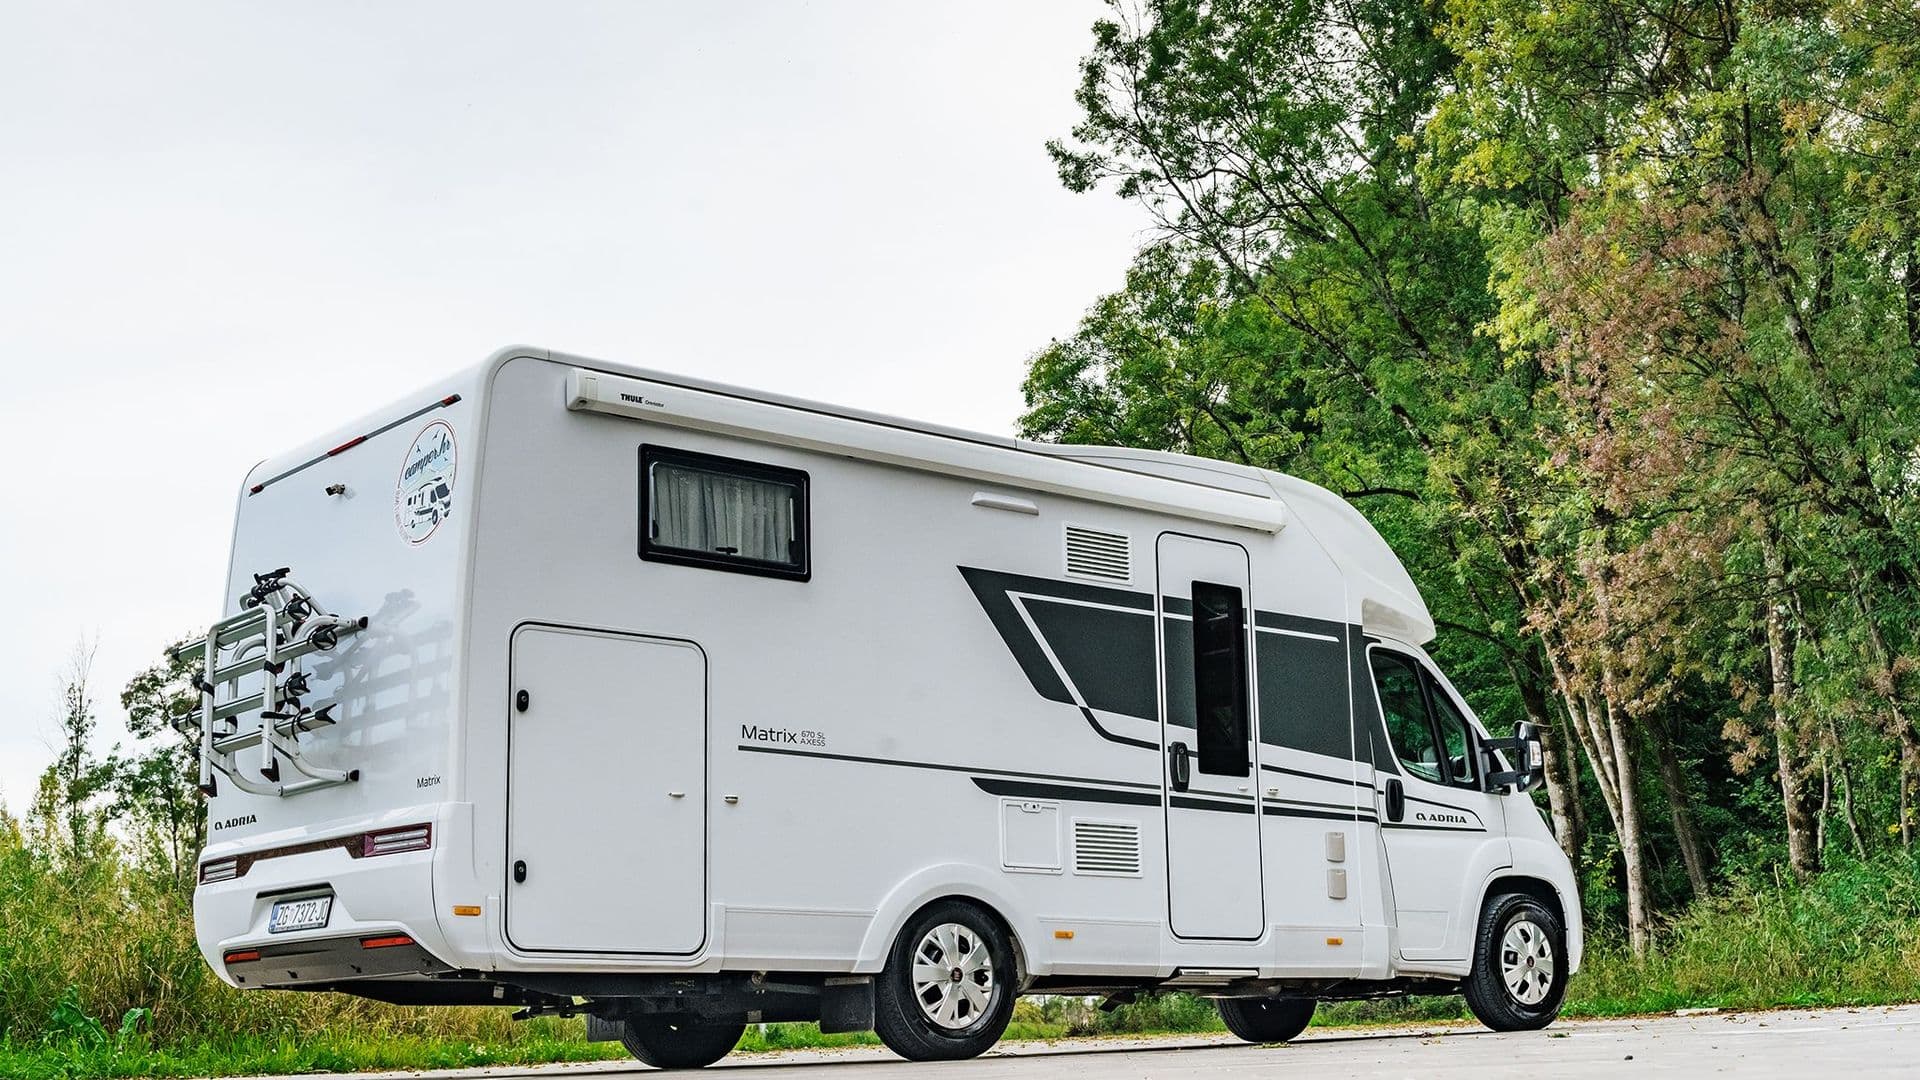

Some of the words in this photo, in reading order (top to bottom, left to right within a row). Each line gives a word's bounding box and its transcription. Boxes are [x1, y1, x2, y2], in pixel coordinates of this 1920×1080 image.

[620, 393, 644, 404] THULE
[404, 432, 451, 480] camper.hr
[741, 724, 797, 744] Matrix
[801, 730, 816, 739] 670
[800, 738, 826, 747] AXESS
[416, 774, 441, 789] Matrix
[224, 814, 257, 829] ADRIA
[1429, 814, 1468, 824] ADRIA
[276, 904, 290, 926] ZG
